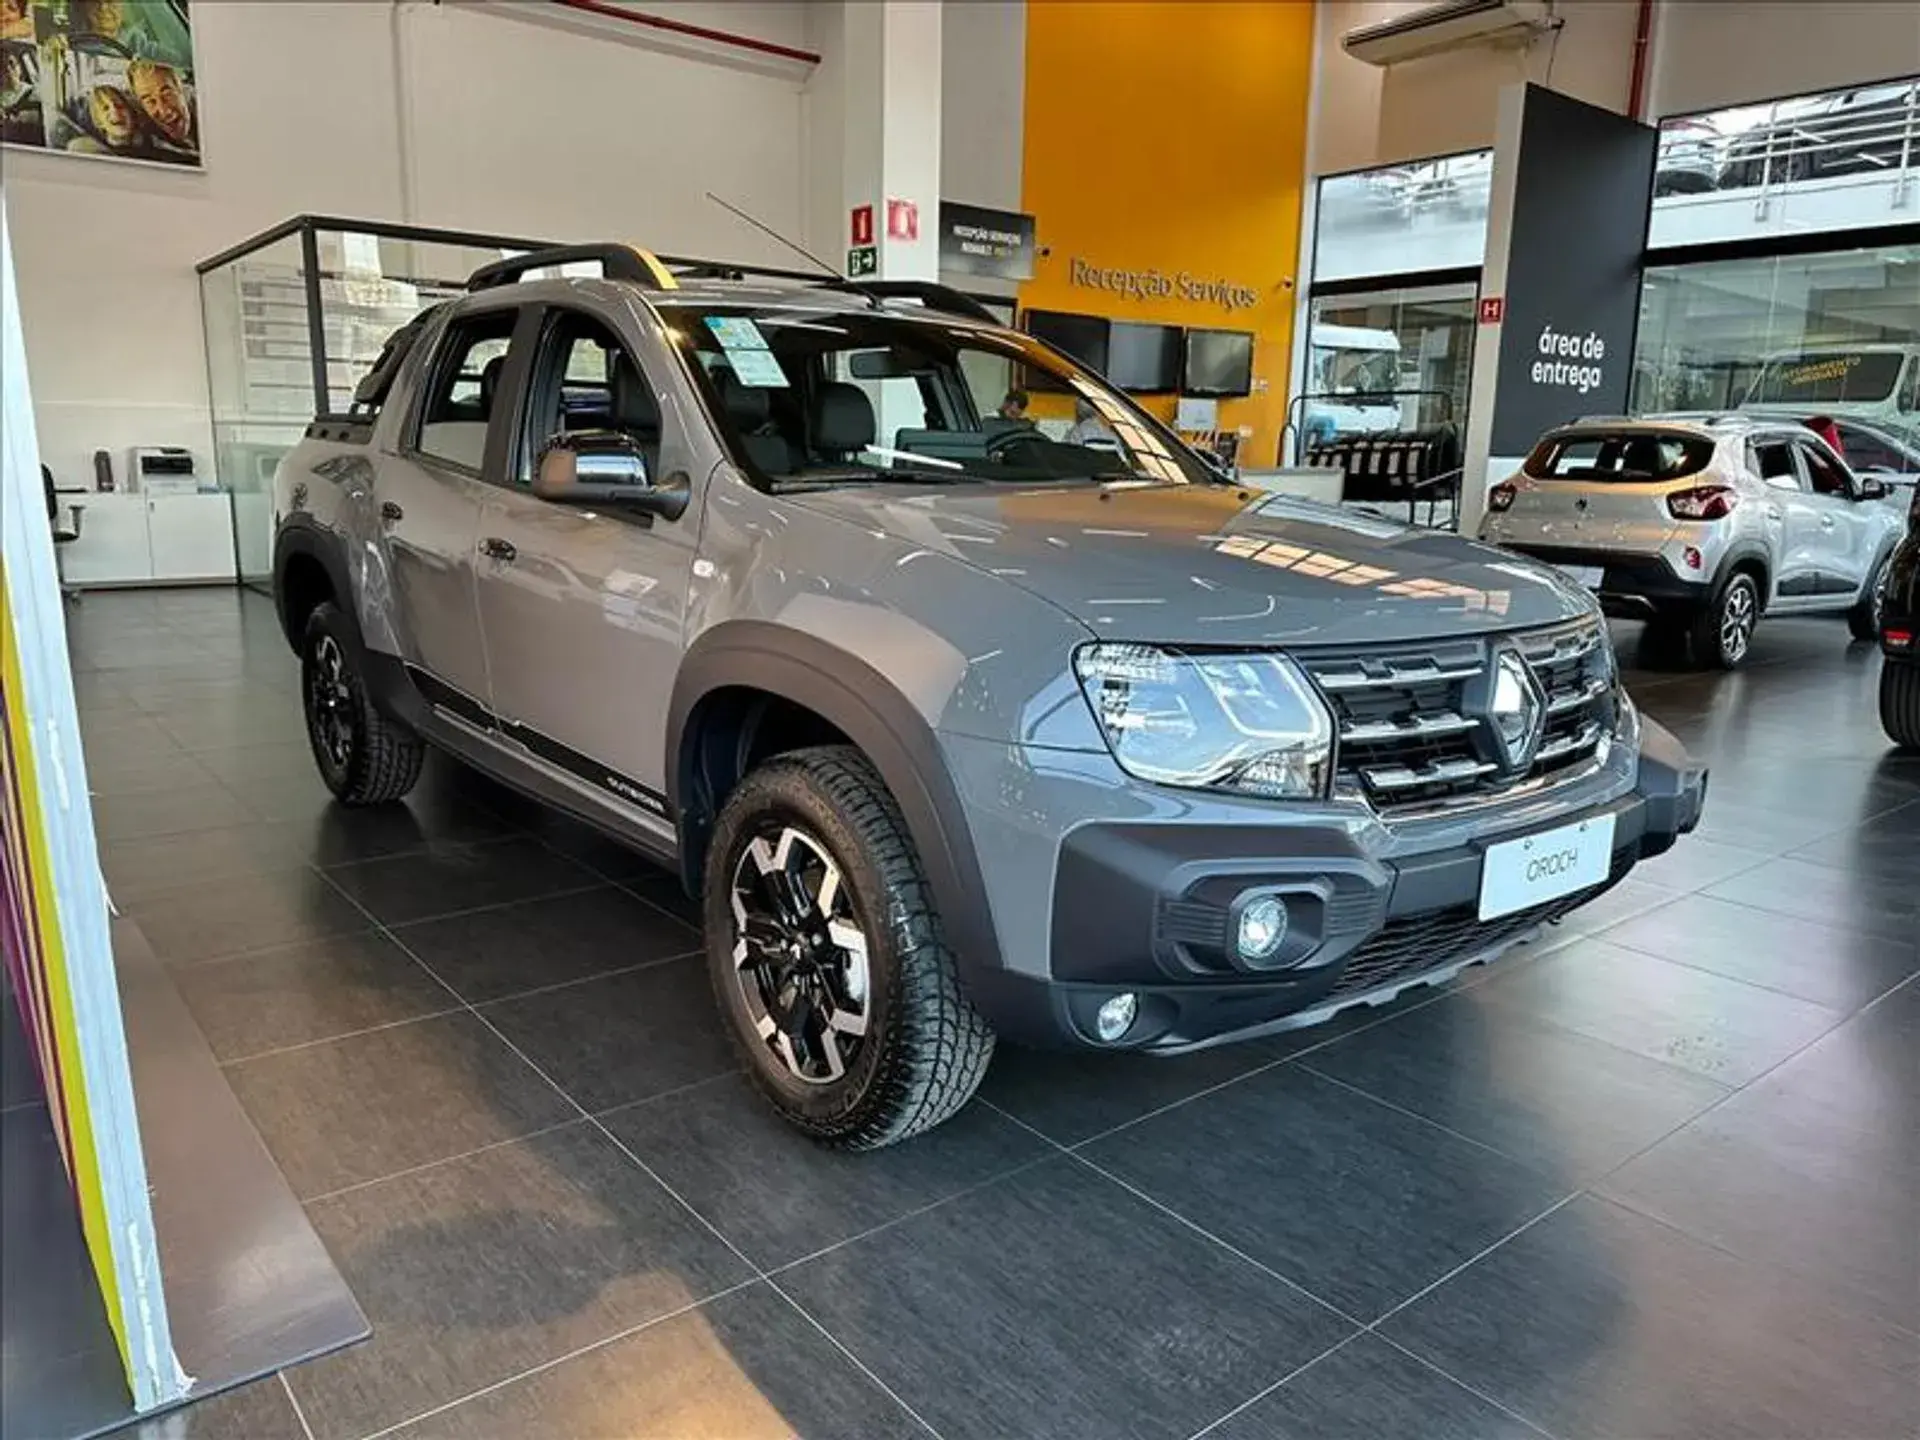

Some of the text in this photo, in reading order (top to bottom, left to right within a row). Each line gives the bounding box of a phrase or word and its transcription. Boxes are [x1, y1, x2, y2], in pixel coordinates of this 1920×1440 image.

[1069, 256, 1257, 312] Recepção Serviços
[1538, 325, 1605, 360] área de
[1531, 360, 1602, 393] entrega
[1526, 848, 1578, 882] OROCH
